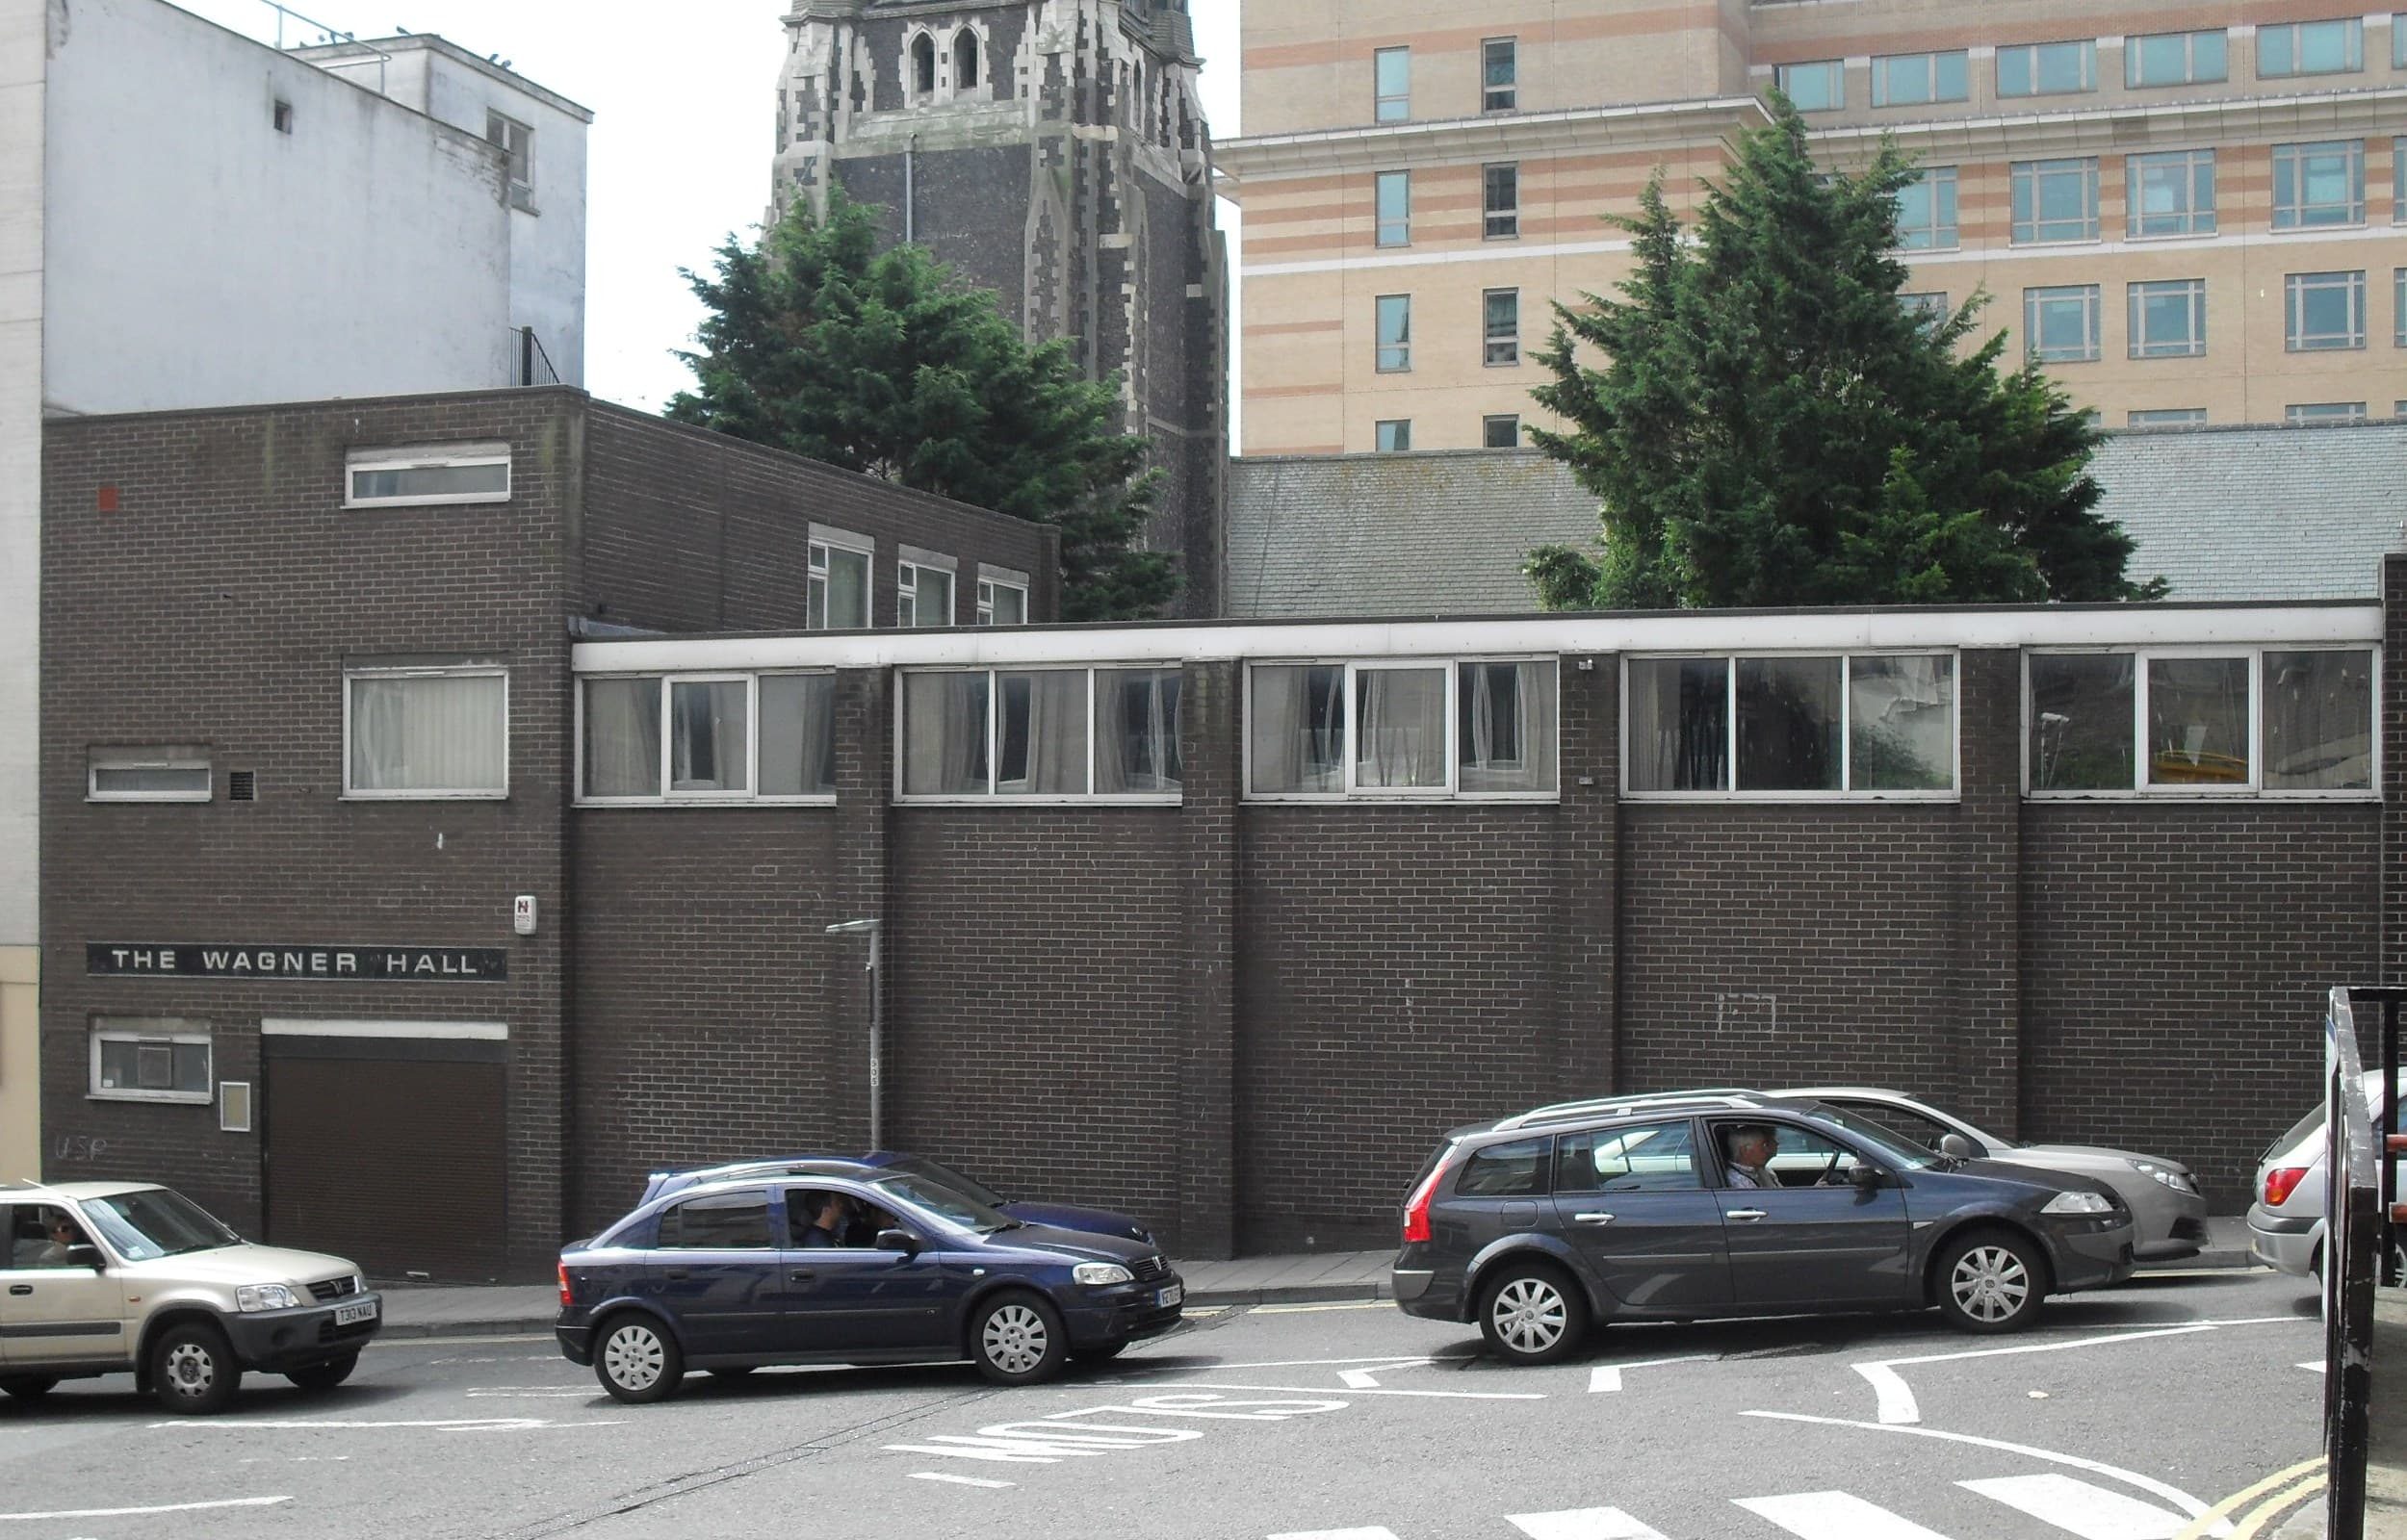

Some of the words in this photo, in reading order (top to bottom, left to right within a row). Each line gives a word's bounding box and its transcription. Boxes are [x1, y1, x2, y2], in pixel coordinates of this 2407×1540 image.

[112, 950, 175, 968] THE
[202, 951, 356, 972] WAGNER
[386, 954, 478, 973] HALL
[879, 1394, 1350, 1463] SLOW
